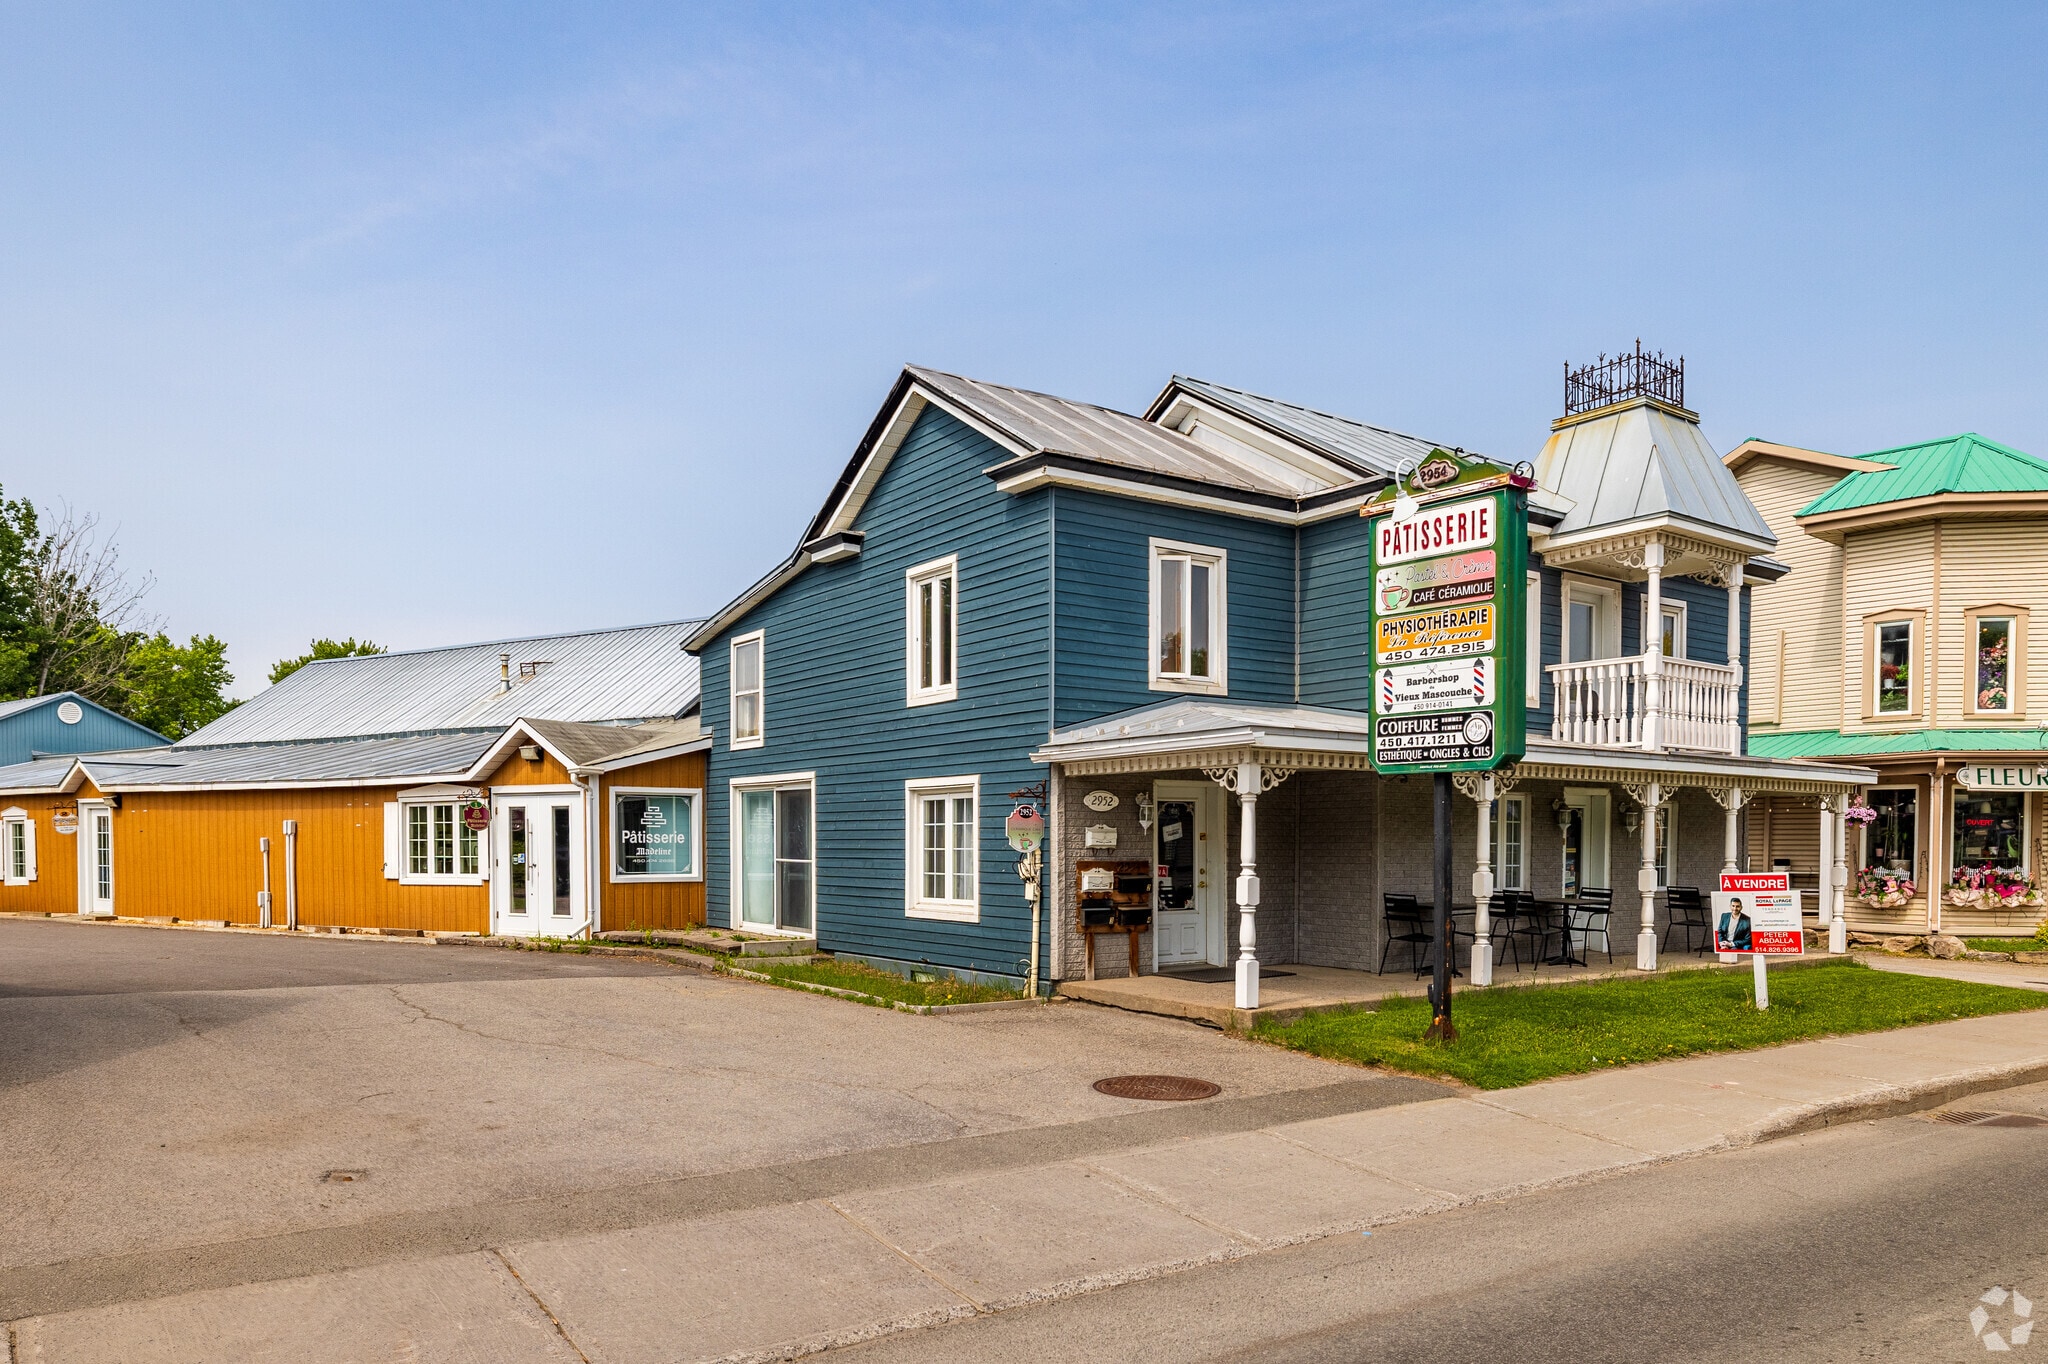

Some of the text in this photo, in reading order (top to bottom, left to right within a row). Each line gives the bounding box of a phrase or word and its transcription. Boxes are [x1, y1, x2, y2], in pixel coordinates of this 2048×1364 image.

[1420, 465, 1448, 482] 2954
[1383, 508, 1488, 558] PÂTISSERIE
[1406, 558, 1492, 586] Pastel & Crème
[1413, 581, 1493, 603] CAFÉ CÉRAMIQUE
[1382, 609, 1488, 637] PHYSIOTHÉRAPIE
[1387, 629, 1482, 648] La Référence
[1385, 641, 1486, 661] 450 474.2915
[1406, 674, 1460, 687] Barbershop
[1395, 687, 1473, 702] Vieux Mascouche
[1425, 700, 1453, 708] 914-0141
[1379, 719, 1438, 735] COIFFURE
[1380, 734, 1457, 748] 450.417.1211
[1379, 746, 1491, 761] ESTHÉTIQUE ONGLES & CILS
[1091, 795, 1114, 807] 2952
[621, 830, 685, 844] Pâtisserie
[635, 847, 671, 856] Madeline
[1723, 877, 1785, 889] À VENDRE
